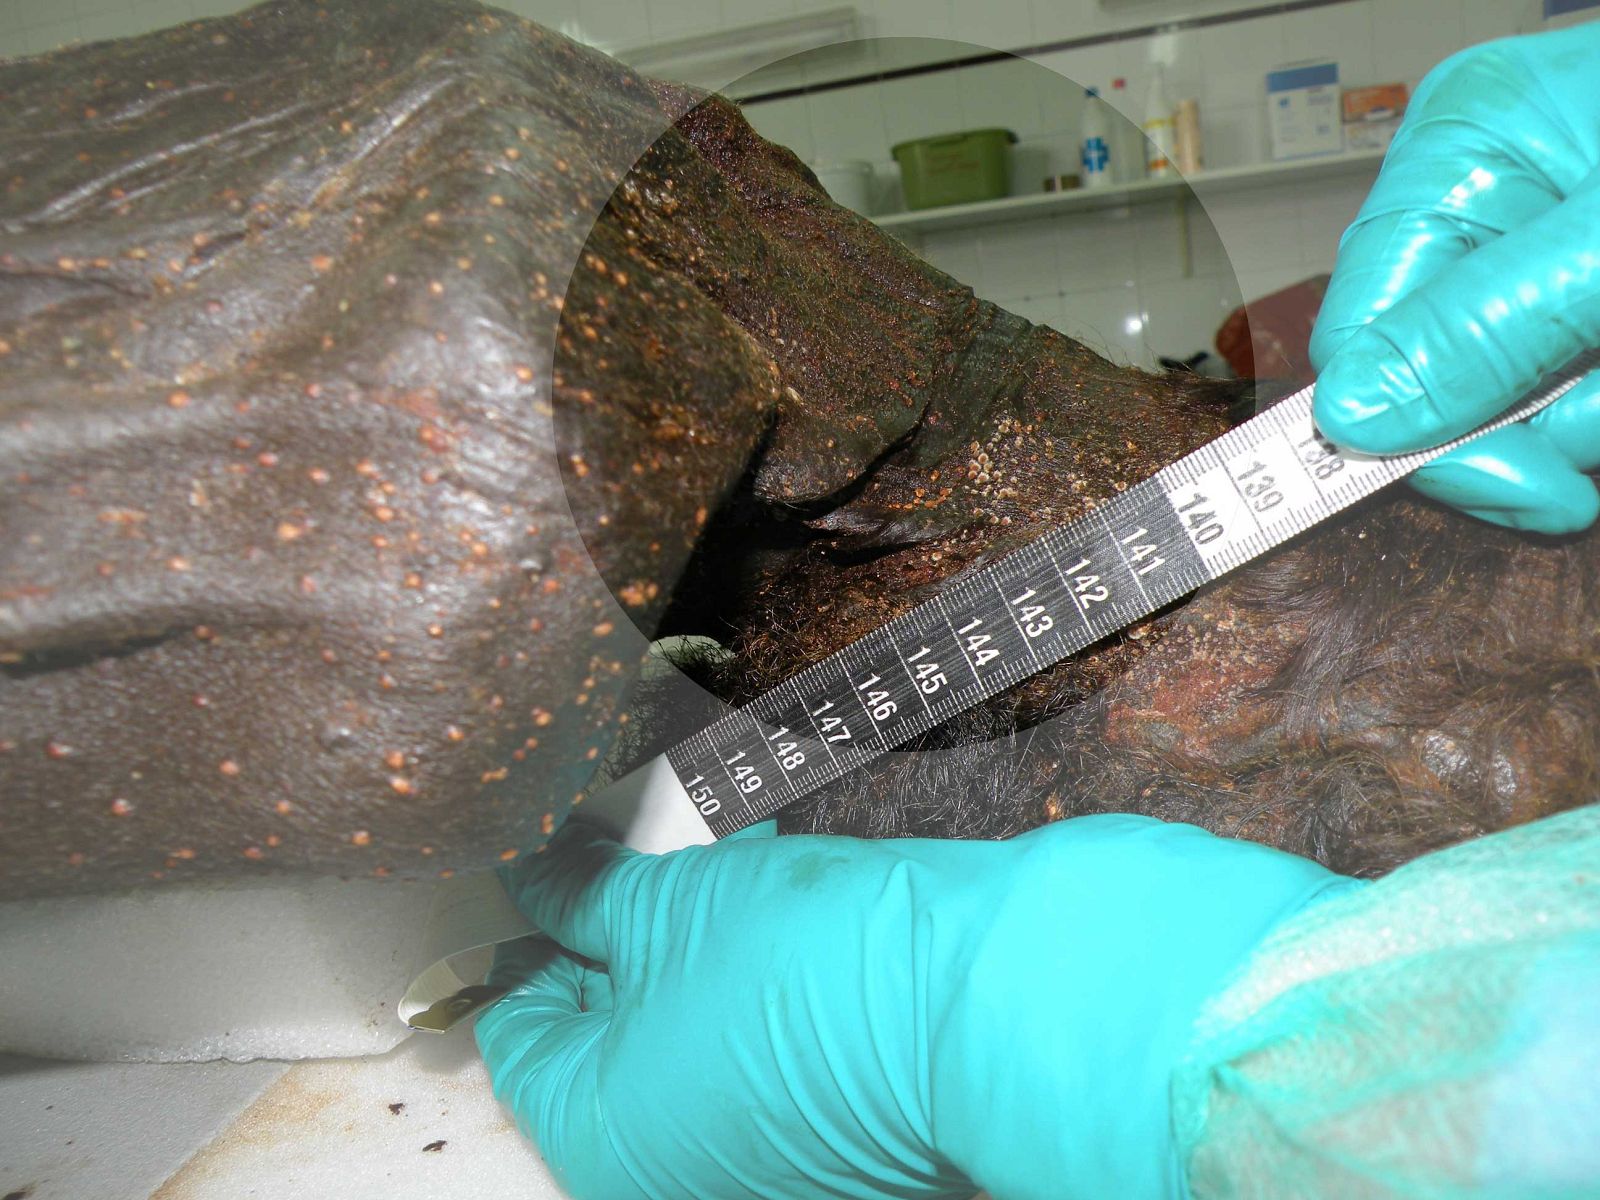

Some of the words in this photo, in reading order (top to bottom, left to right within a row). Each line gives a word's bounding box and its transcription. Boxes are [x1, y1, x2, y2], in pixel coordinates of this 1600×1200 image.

[1237, 459, 1285, 513] 139
[1178, 492, 1224, 545] 140
[1120, 527, 1166, 576] 141
[1065, 558, 1109, 609] 142
[1011, 587, 1054, 638] 143
[958, 616, 1000, 667] 144
[907, 646, 948, 694] 145
[858, 672, 898, 721] 146
[812, 700, 852, 744] 147
[726, 750, 763, 794] 149
[768, 724, 806, 771] 148
[685, 773, 722, 817] 150
